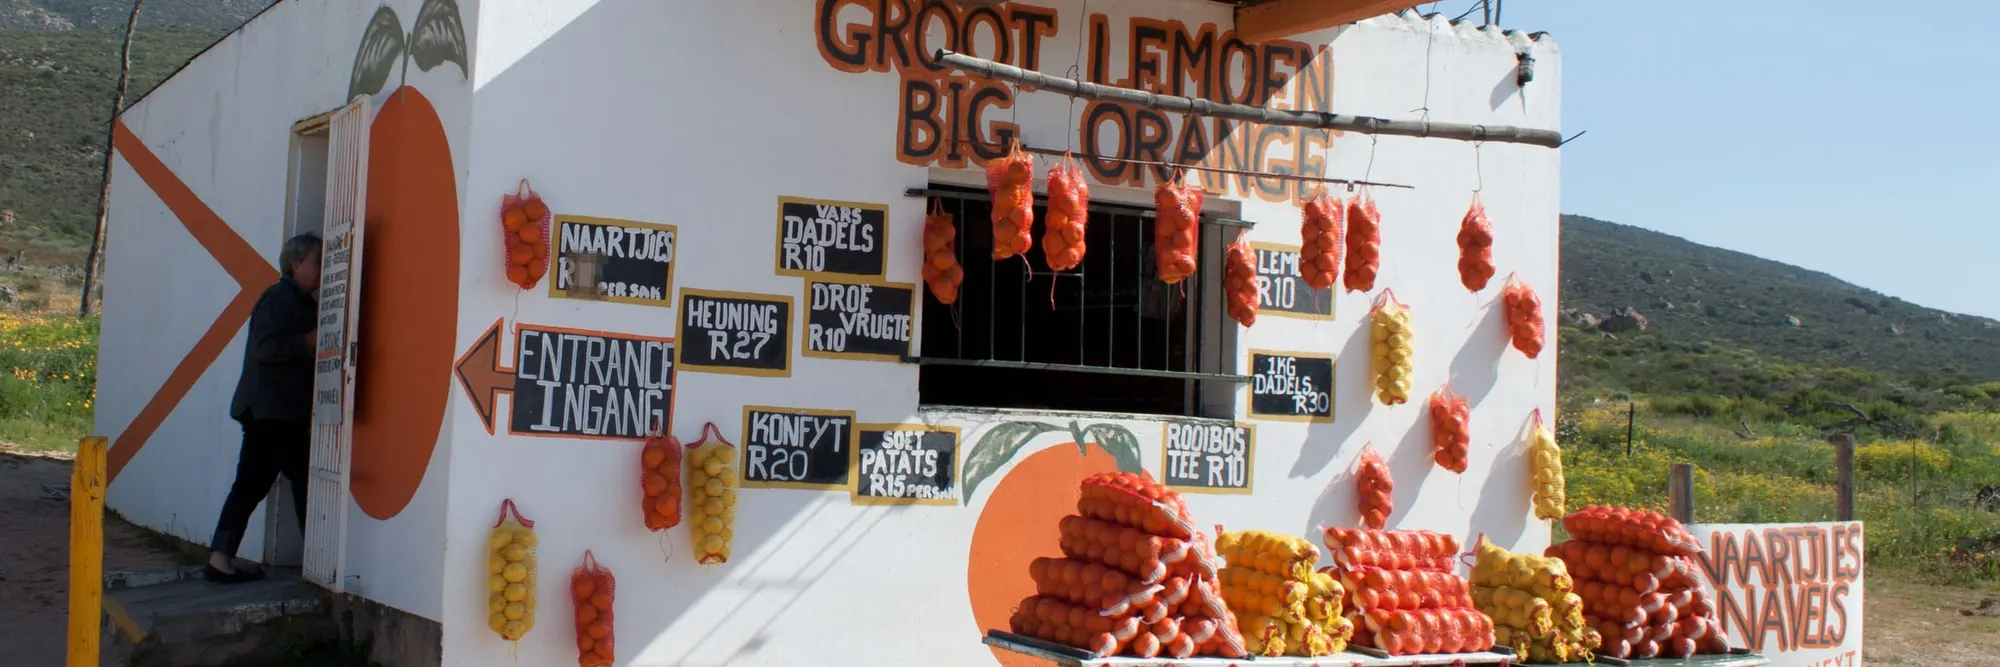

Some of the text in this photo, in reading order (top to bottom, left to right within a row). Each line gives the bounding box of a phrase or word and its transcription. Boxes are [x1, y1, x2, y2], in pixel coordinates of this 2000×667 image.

[815, 0, 1058, 88] GROOT
[1087, 13, 1334, 112] LEMOEN
[897, 75, 1020, 168] BIG
[1081, 98, 1341, 206] ORANGE
[816, 204, 862, 225] VARS
[560, 222, 674, 263] NAARTJIES
[784, 215, 873, 252] DADELS
[783, 243, 825, 272] R10
[597, 281, 661, 300] PER SAK
[812, 283, 873, 314] DROË
[1255, 275, 1295, 309] R10
[687, 300, 778, 334] HEUNING
[839, 312, 910, 342] VRUGTE
[708, 331, 771, 360] R27
[808, 323, 847, 353] R10
[518, 330, 675, 390] ENTRANCE
[1267, 357, 1296, 377] 1KG
[1254, 373, 1312, 396] DADELS
[530, 380, 664, 437] INGANG
[1292, 391, 1329, 414] R30
[751, 411, 847, 452] KONFYT
[881, 430, 925, 451] SOET
[1167, 423, 1245, 456] ROOIBOS
[748, 448, 808, 481] R20
[860, 448, 938, 477] PATATS
[1167, 450, 1245, 488] TEE R10
[869, 473, 907, 497] R15
[1716, 580, 1849, 651] NAVELS
